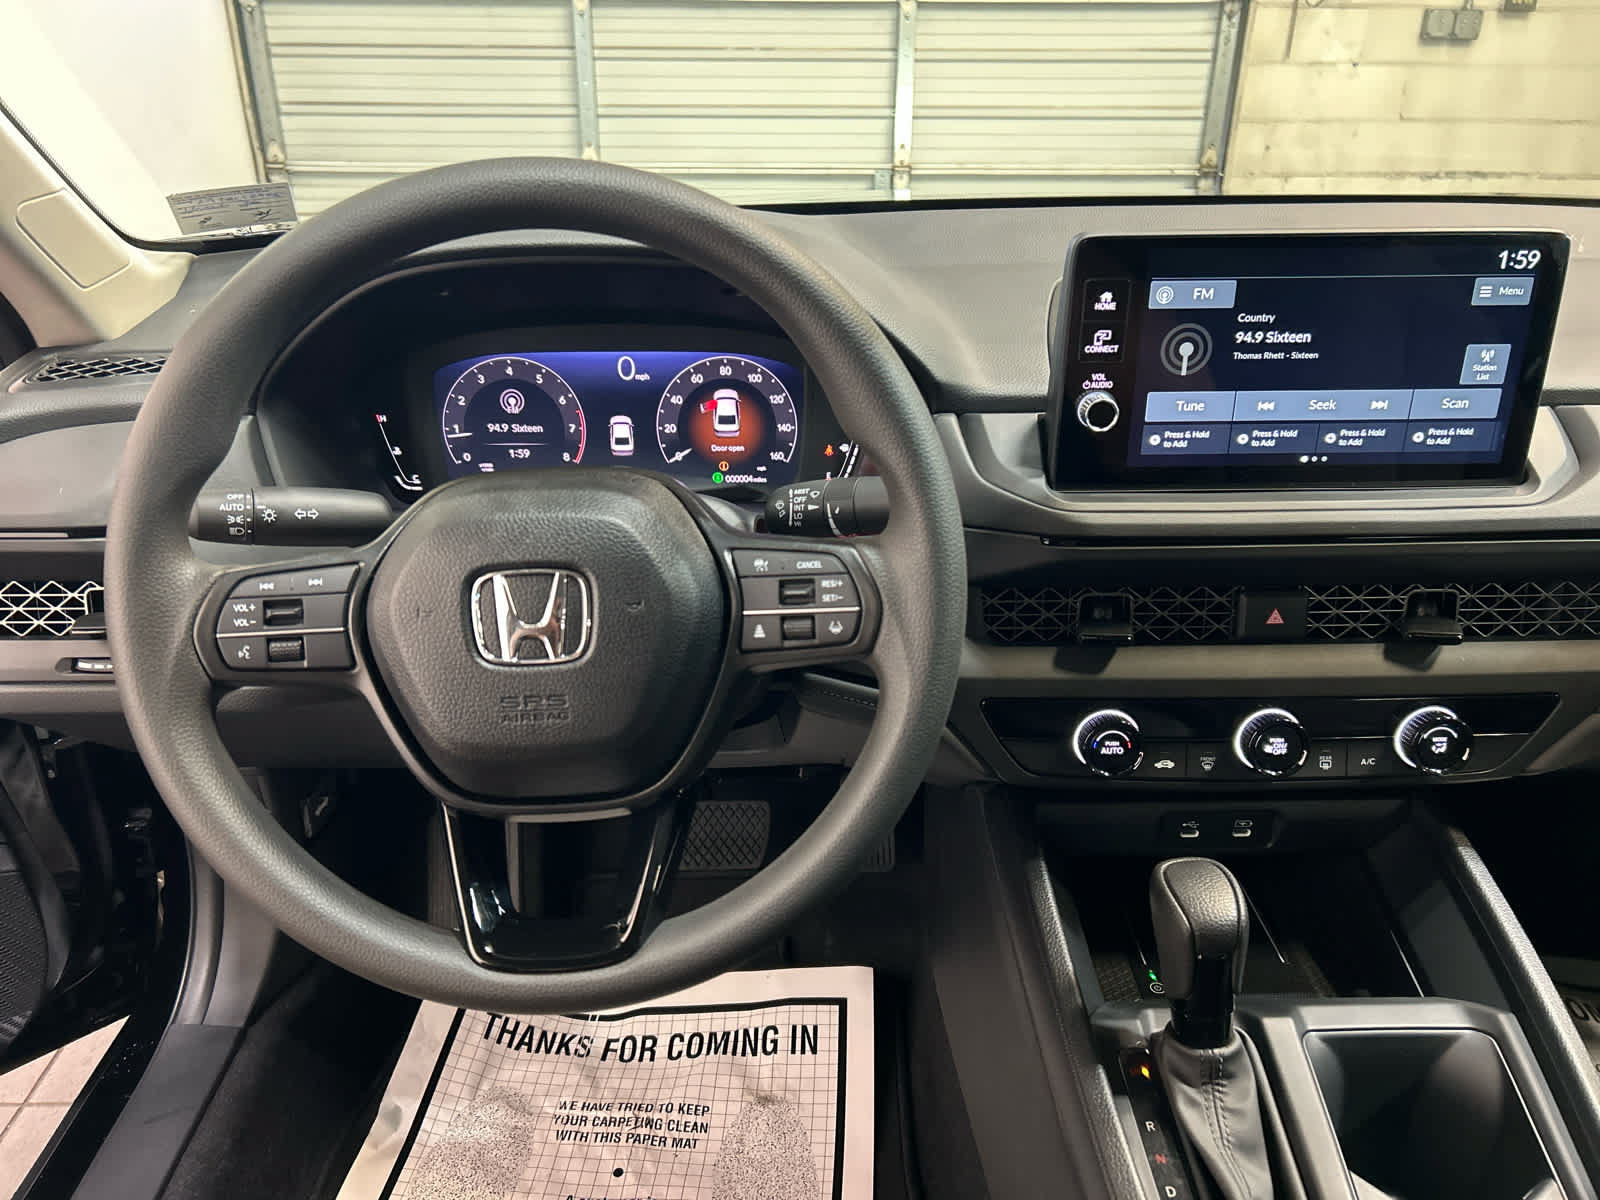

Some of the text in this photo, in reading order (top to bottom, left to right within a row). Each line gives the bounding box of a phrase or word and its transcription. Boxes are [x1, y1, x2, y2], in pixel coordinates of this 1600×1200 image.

[1499, 250, 1541, 270] 1:59
[1193, 287, 1215, 300] FM
[1499, 286, 1525, 296] Menu
[1094, 301, 1117, 311] HOME
[1237, 313, 1276, 324] Country
[1235, 331, 1312, 344] 94.9 Sixteen
[1084, 345, 1119, 353] CONNECT
[1234, 352, 1262, 360] Thomas
[1264, 352, 1285, 360] Rhett
[1291, 351, 1319, 359] Sixteen
[505, 366, 513, 376] 4
[617, 356, 650, 381] 0 mph
[719, 366, 732, 376] 80
[477, 374, 485, 384] 3
[535, 374, 543, 384] 5
[691, 374, 704, 384] 60
[747, 374, 763, 384] 100
[1476, 373, 1490, 381] List
[1090, 381, 1114, 389] AUDIO
[458, 396, 466, 406] 2
[559, 396, 567, 405] 6
[670, 395, 683, 405] 40
[769, 394, 784, 404] 120
[1441, 398, 1470, 409] Scan
[1176, 401, 1206, 412] Tune
[1308, 400, 1337, 411] Seek
[453, 424, 459, 434] 1
[487, 424, 543, 433] 94.9 Sixteen
[569, 424, 576, 433] 7
[664, 424, 677, 433] 20
[777, 423, 792, 432] 140
[1428, 428, 1448, 436] Press
[1164, 431, 1184, 439] Press
[1252, 430, 1272, 438] Press
[1340, 429, 1360, 437] Press
[711, 444, 728, 452] Door
[463, 453, 471, 462] 0
[508, 449, 530, 459] 1:59
[563, 453, 571, 462] 8
[770, 451, 784, 460] 160
[725, 475, 753, 483] 000004
[796, 561, 822, 569] CANCEL
[501, 696, 569, 710] SRS
[503, 711, 569, 723] AIRBAG
[1100, 747, 1124, 755] AUTO
[1360, 758, 1376, 766] A/C
[484, 1012, 818, 1064] THANKS FOR COMING IN
[559, 1101, 710, 1117] WE HAVE TRIED TO KEEP
[554, 1114, 709, 1134] YOUR CARPETING CLEAN
[1145, 1121, 1155, 1132] R
[556, 1129, 699, 1149] WITH THIS PAPER MAT
[1155, 1153, 1167, 1164] N
[1165, 1186, 1176, 1198] D
